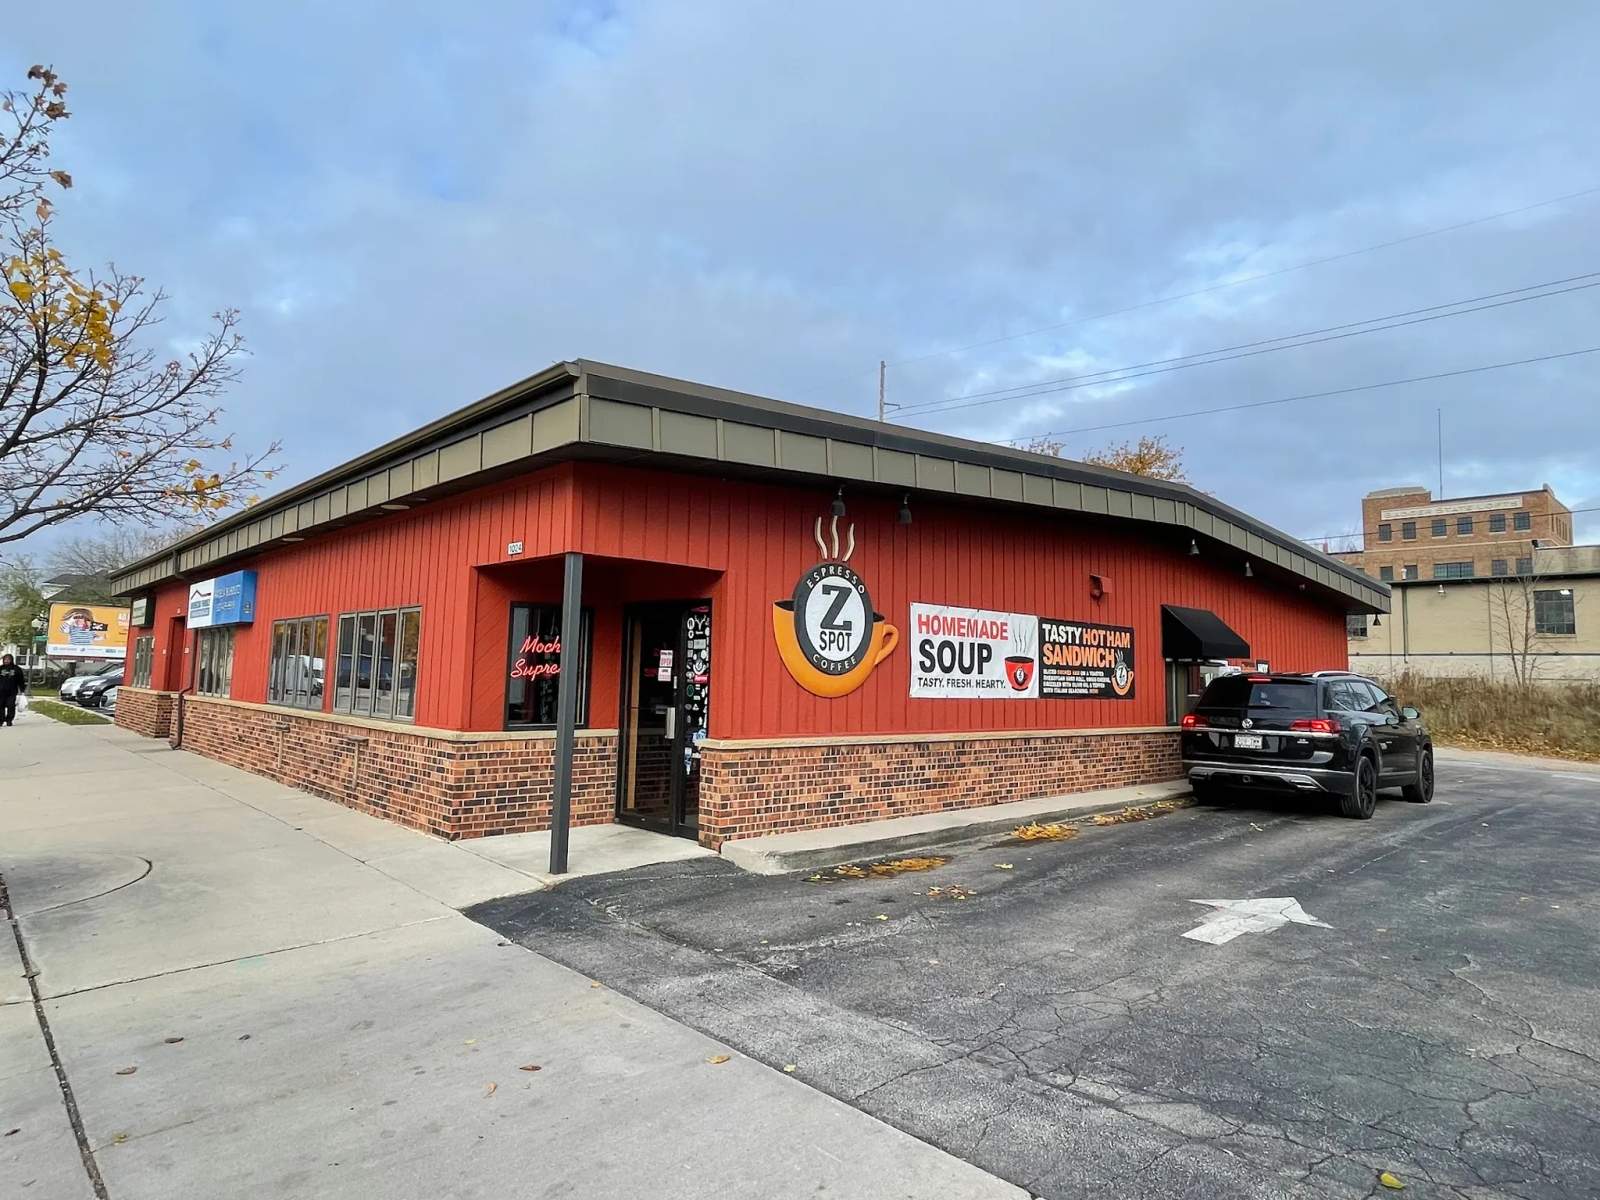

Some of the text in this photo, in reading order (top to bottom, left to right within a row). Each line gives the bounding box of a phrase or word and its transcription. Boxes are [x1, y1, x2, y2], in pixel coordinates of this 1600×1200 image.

[509, 543, 522, 553] 1024
[807, 565, 865, 594] ESPRESSO
[820, 584, 853, 631] Z
[917, 613, 1009, 641] HOMEMADE
[1042, 623, 1130, 648] TASTY HOT HAM
[520, 635, 560, 653] Moch
[819, 630, 853, 652] SPOT
[812, 654, 857, 671] COFFEE
[919, 638, 993, 675] SOUP
[1043, 643, 1115, 668] SANDWICH
[511, 658, 560, 681] Supre
[917, 677, 1006, 689] TASTY. FRESH. HEARTY.
